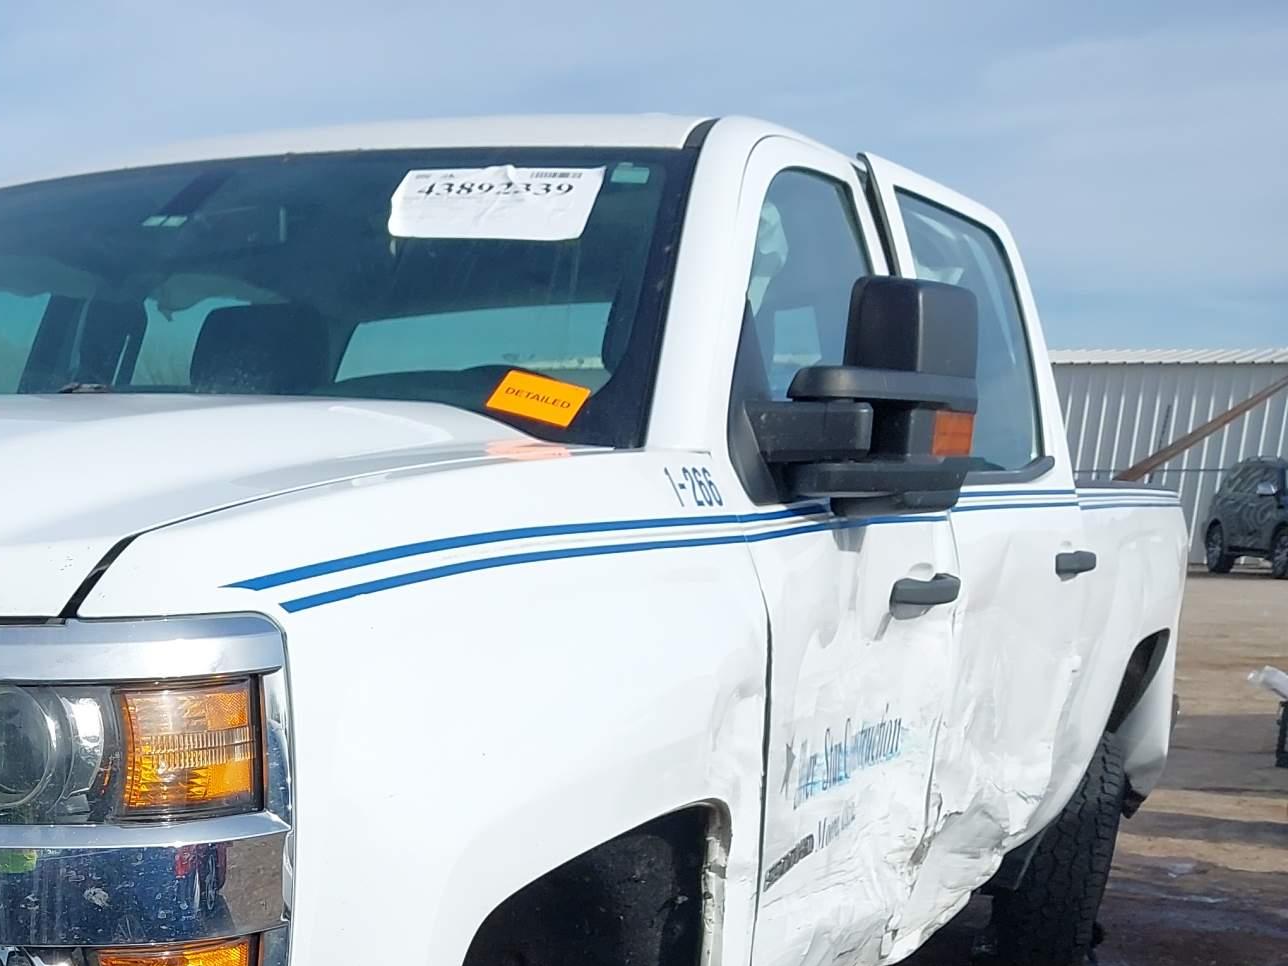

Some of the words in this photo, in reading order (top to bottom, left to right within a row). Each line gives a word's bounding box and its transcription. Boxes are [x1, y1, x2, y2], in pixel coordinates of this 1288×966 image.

[417, 181, 575, 197] 43892339
[504, 386, 571, 409] DETAILED
[663, 466, 724, 508] 1-266
